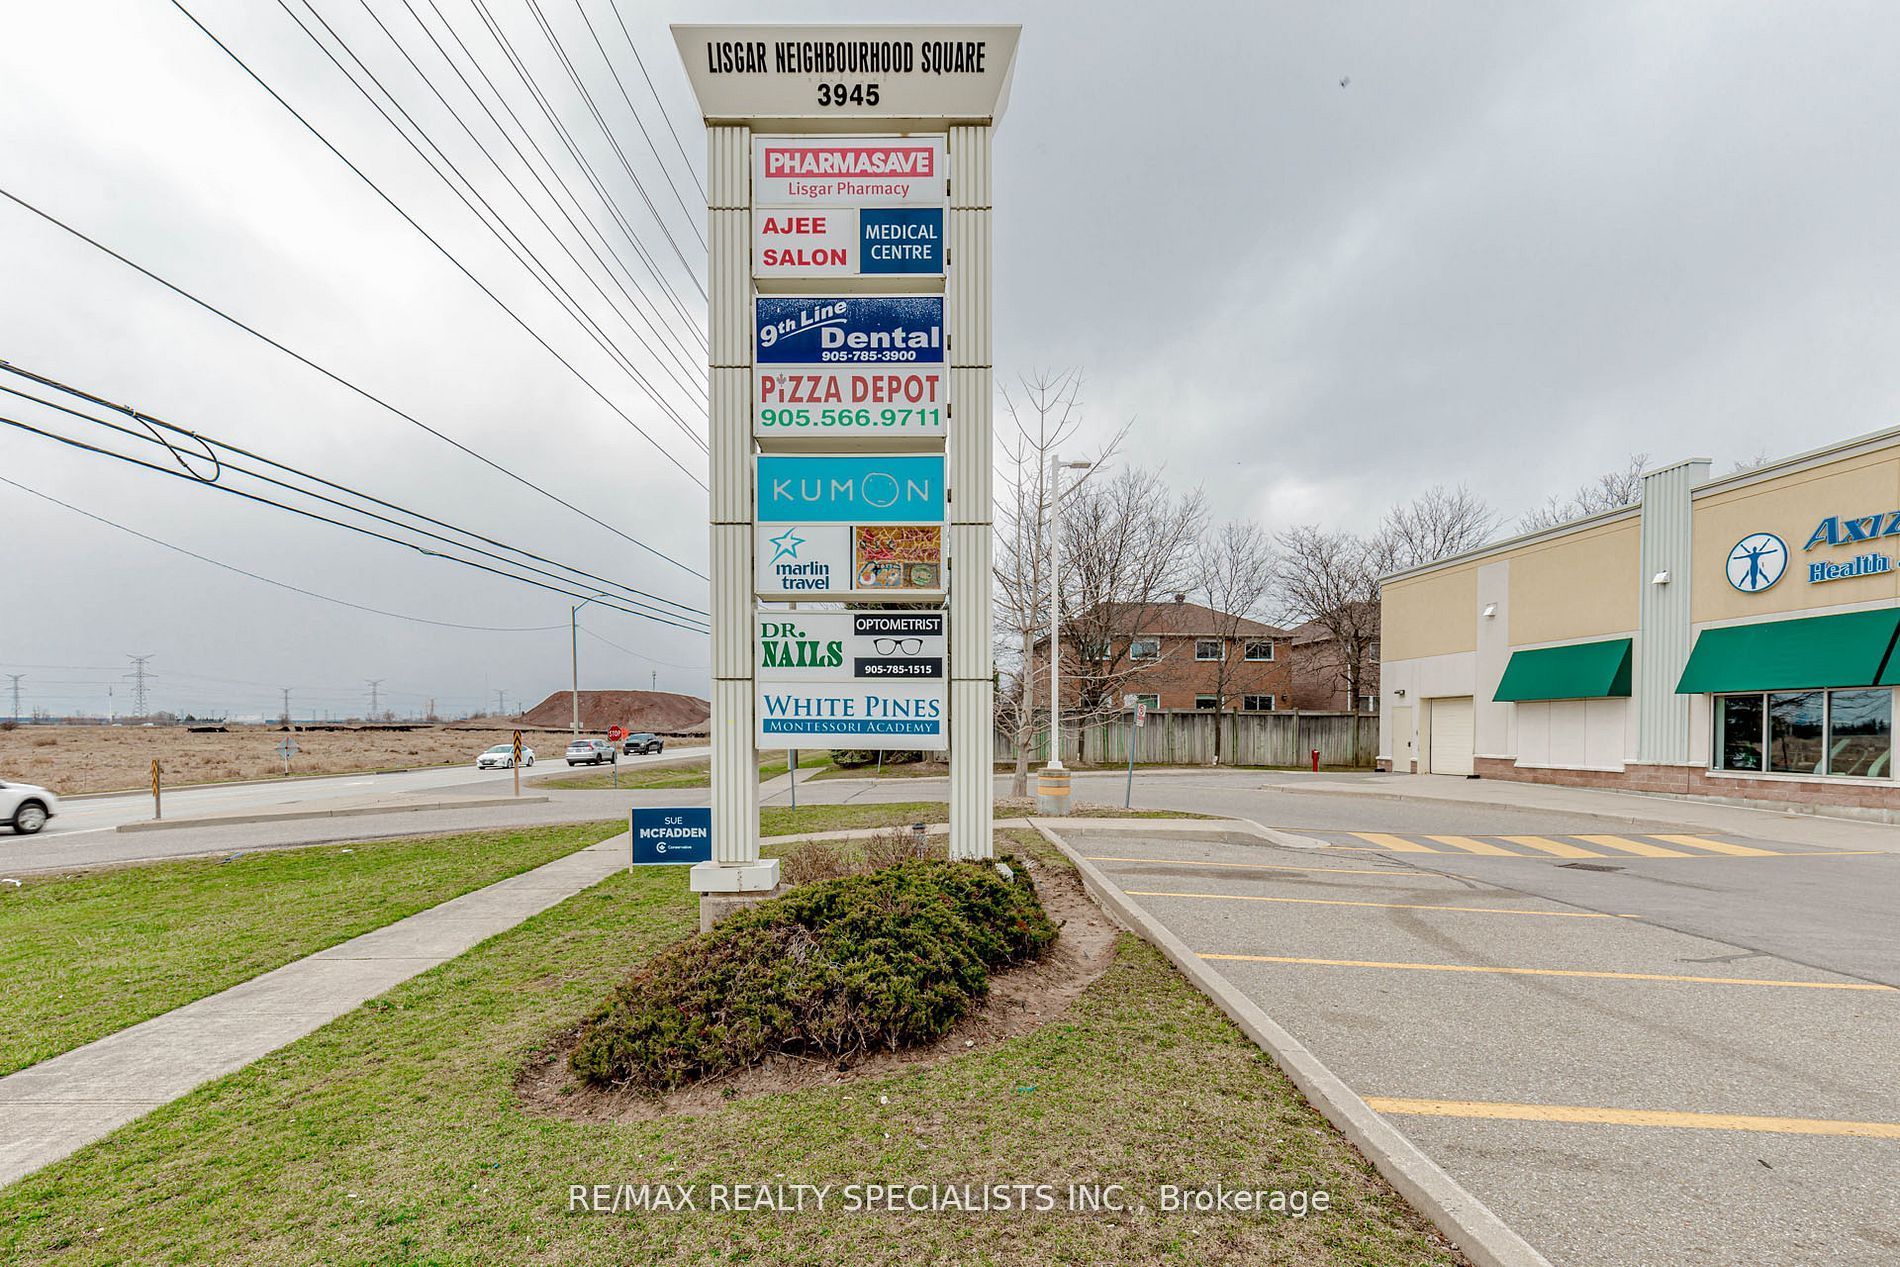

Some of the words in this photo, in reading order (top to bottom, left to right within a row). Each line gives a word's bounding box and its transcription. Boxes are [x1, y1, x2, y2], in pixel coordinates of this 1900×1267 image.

[707, 41, 768, 73] LISGAR
[775, 41, 914, 73] NEIGHBOURHOOD
[921, 41, 986, 75] SQUARE
[817, 83, 880, 106] 3945
[769, 152, 930, 174] PHARMASAVE
[788, 181, 833, 198] Lisgar
[837, 182, 910, 199] Pharmacy
[762, 217, 827, 234] AJEE
[865, 224, 938, 240] MEDICAL
[762, 248, 848, 266] SALON
[870, 244, 933, 260] CENTRE
[760, 318, 797, 347] 9th
[800, 301, 848, 326] Line
[821, 326, 940, 349] Dental
[821, 350, 917, 361] 905-785-3900
[851, 374, 940, 403] DEPOT
[760, 408, 940, 427] 905.566.9711
[773, 472, 929, 508] KUMON
[776, 561, 829, 575] marlin
[1807, 553, 1891, 583] Health
[782, 575, 830, 590] travel
[760, 622, 806, 638] DR.
[856, 618, 941, 631] OPTOMETRIST
[761, 641, 843, 668] NAILS
[864, 665, 932, 674] 905-785-1515
[664, 816, 683, 825] SUE
[640, 827, 707, 838] MCFADDEN
